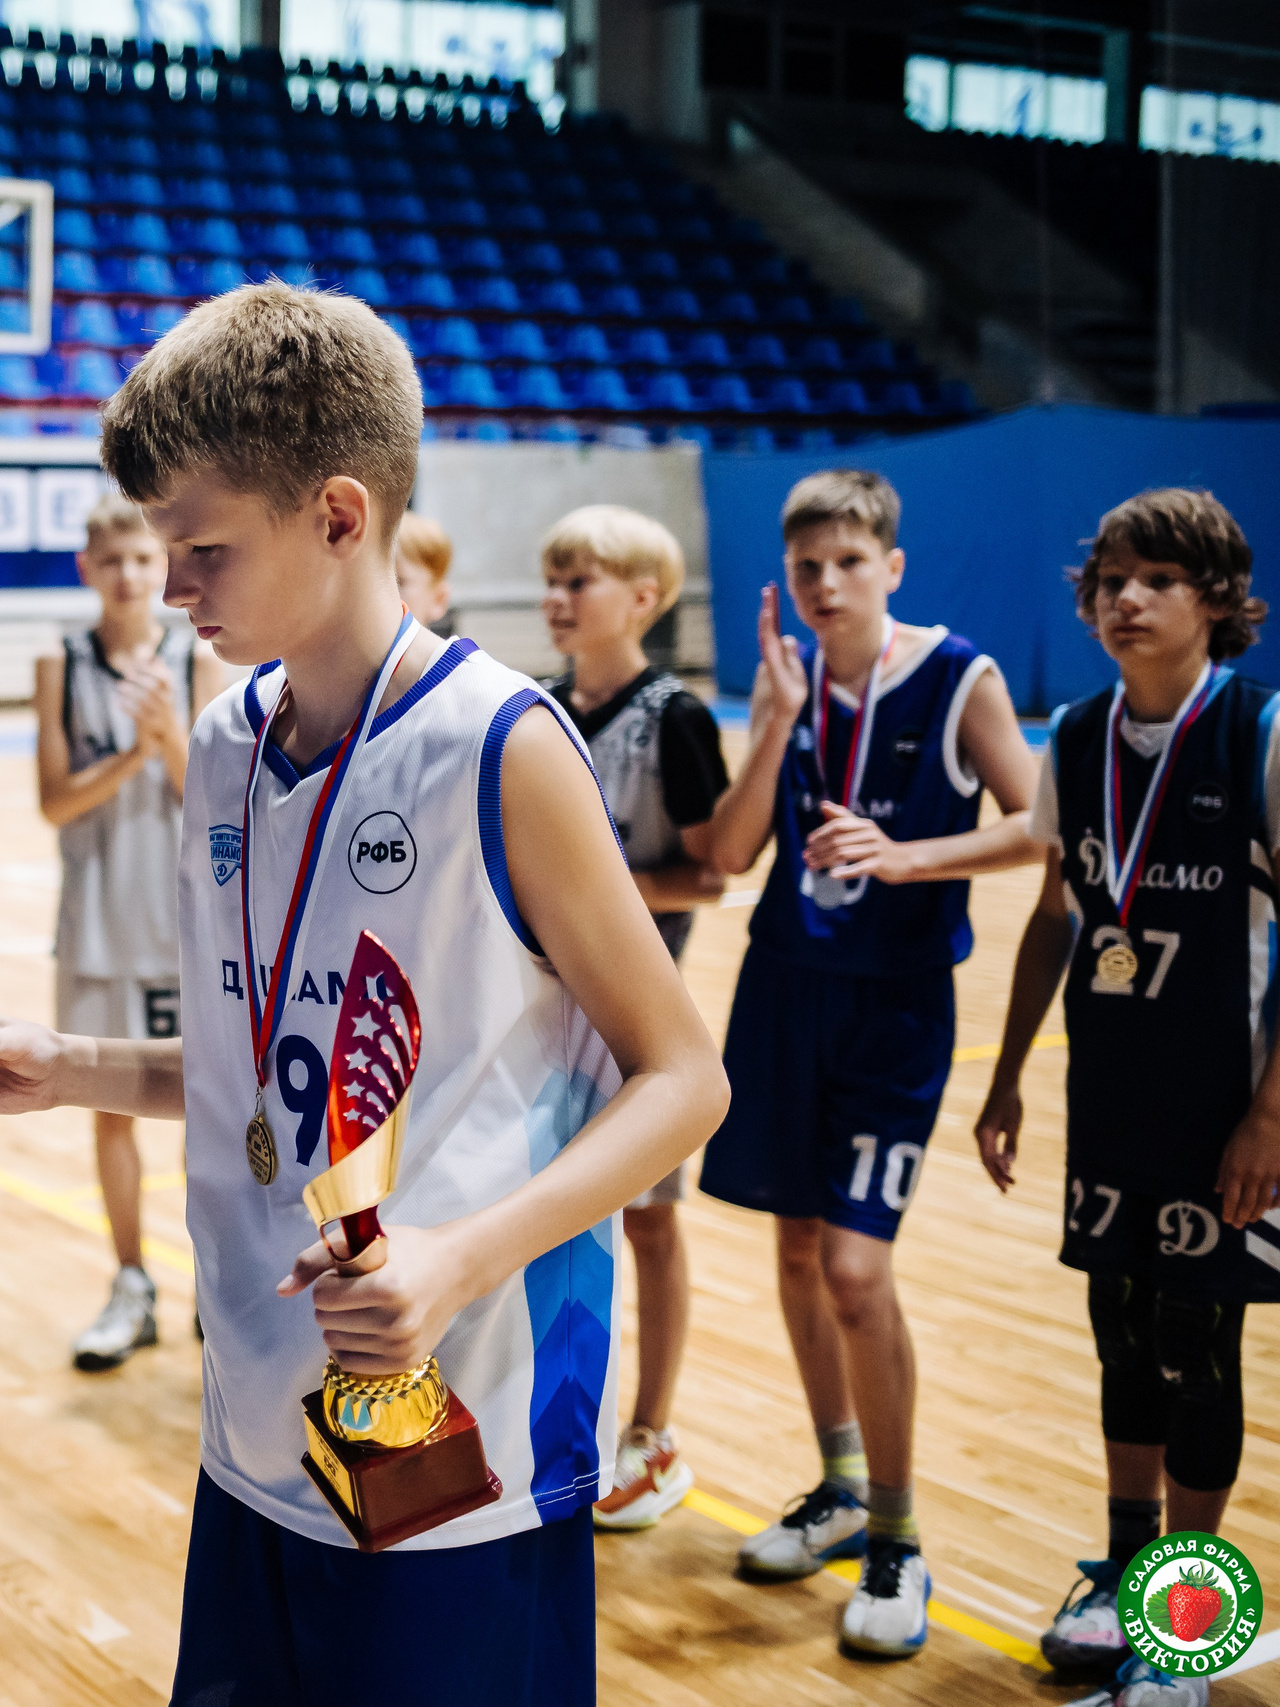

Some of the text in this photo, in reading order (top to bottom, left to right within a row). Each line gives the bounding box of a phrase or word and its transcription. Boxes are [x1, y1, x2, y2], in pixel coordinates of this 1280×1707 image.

[357, 840, 407, 864] РФБ
[276, 1034, 329, 1167] 9
[848, 1133, 924, 1212] 10
